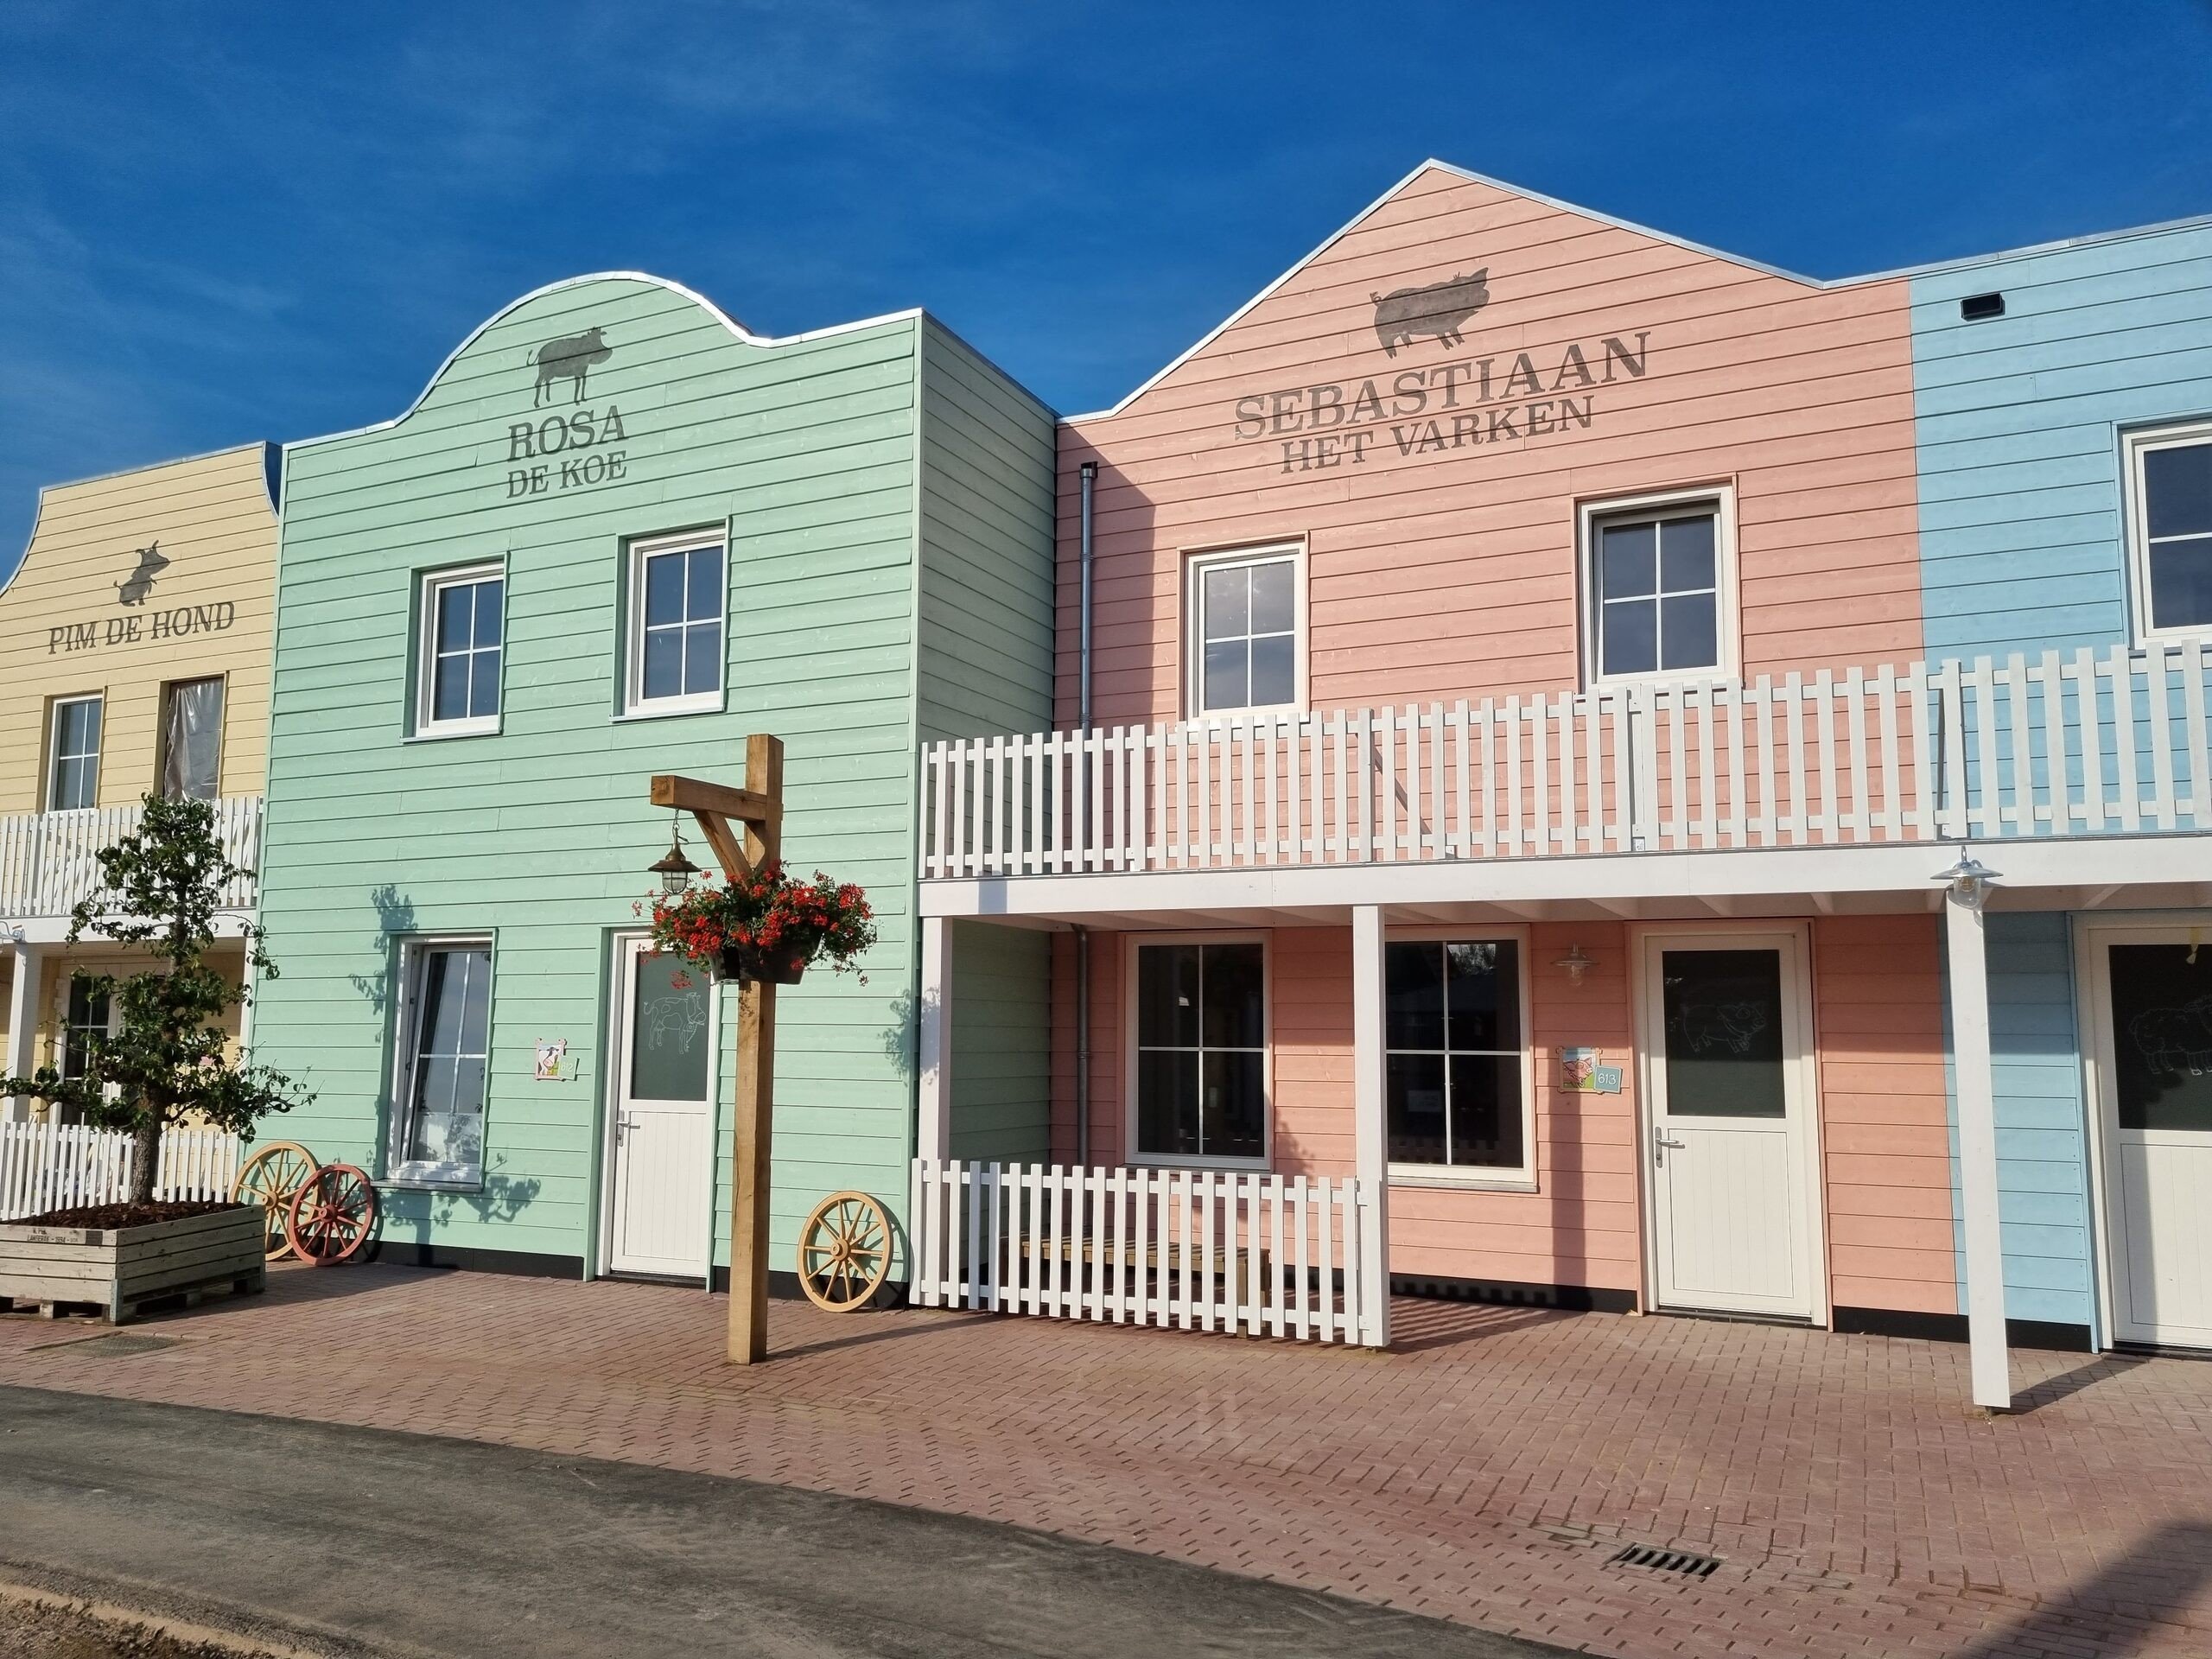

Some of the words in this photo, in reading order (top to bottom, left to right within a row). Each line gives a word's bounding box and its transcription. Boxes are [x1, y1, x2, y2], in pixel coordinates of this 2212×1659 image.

[1234, 331, 1651, 441] SEBASTIAAN
[507, 405, 629, 462] ROSA
[1281, 429, 1374, 474] HET
[1389, 395, 1595, 456] VARKEN
[506, 465, 550, 499] DE
[559, 450, 627, 490] KOE
[48, 620, 98, 654] PIM
[105, 614, 142, 646] DE
[150, 601, 235, 639] HOND
[1598, 1072, 1617, 1085] 613
